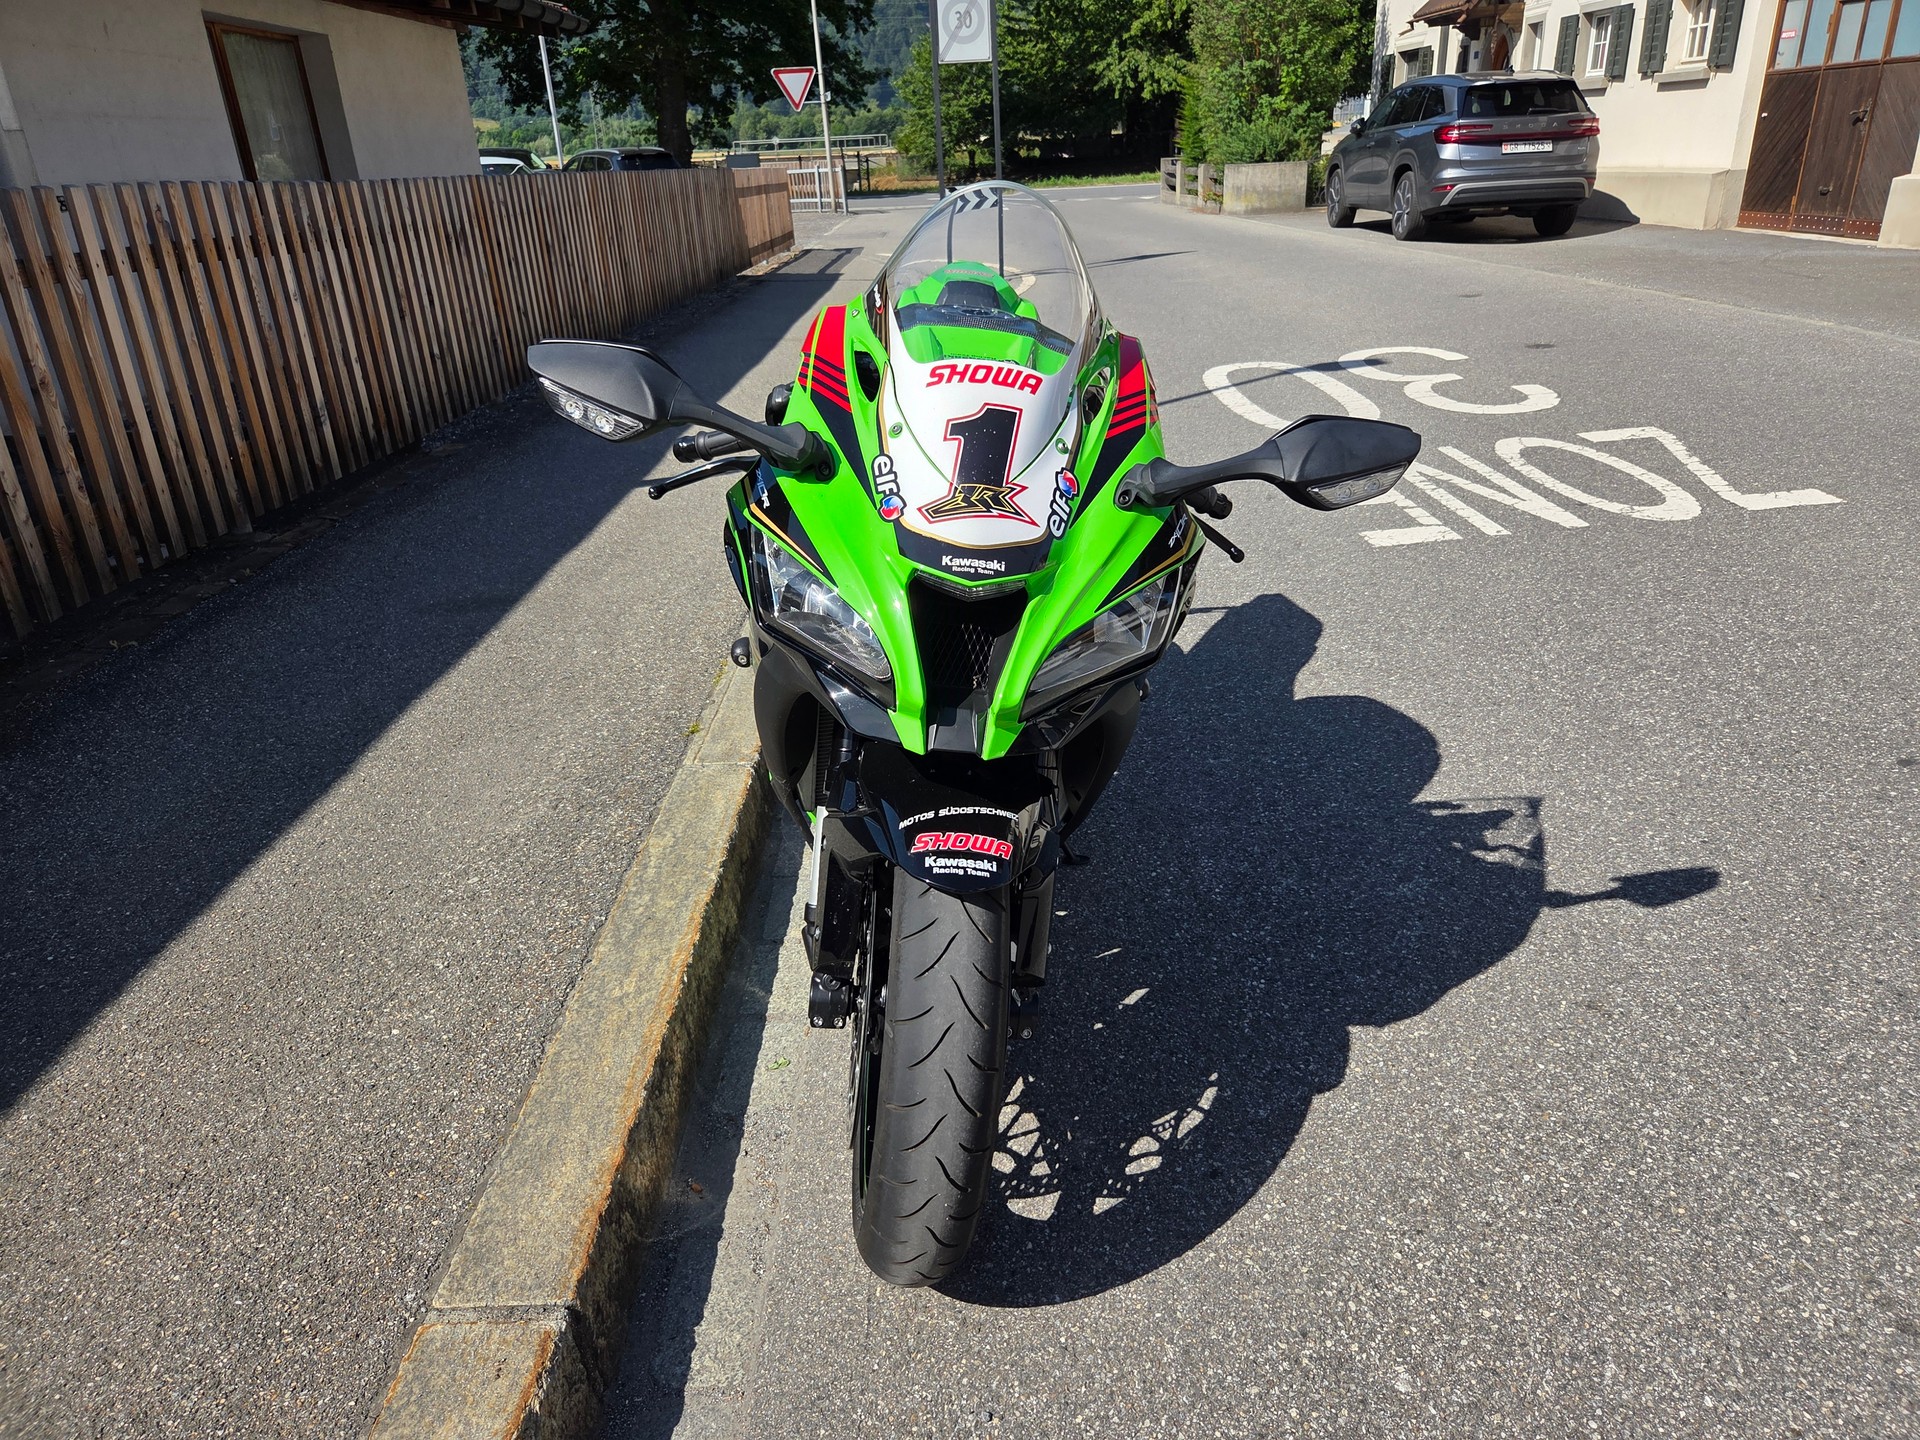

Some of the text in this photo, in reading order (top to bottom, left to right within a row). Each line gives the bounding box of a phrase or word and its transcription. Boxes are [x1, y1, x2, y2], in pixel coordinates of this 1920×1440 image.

[955, 11, 972, 29] 30
[1509, 143, 1519, 152] GR
[926, 363, 1043, 396] SHOWA
[1202, 346, 1561, 431] 30
[873, 455, 898, 495] elf
[1049, 490, 1071, 537] elf
[941, 555, 1006, 572] Kawasaki
[952, 565, 995, 576] Racing Team
[898, 810, 935, 830] MOTOS
[911, 832, 1013, 859] SHOWA
[925, 856, 997, 872] Kawasaki
[932, 867, 990, 878] Racing Team
